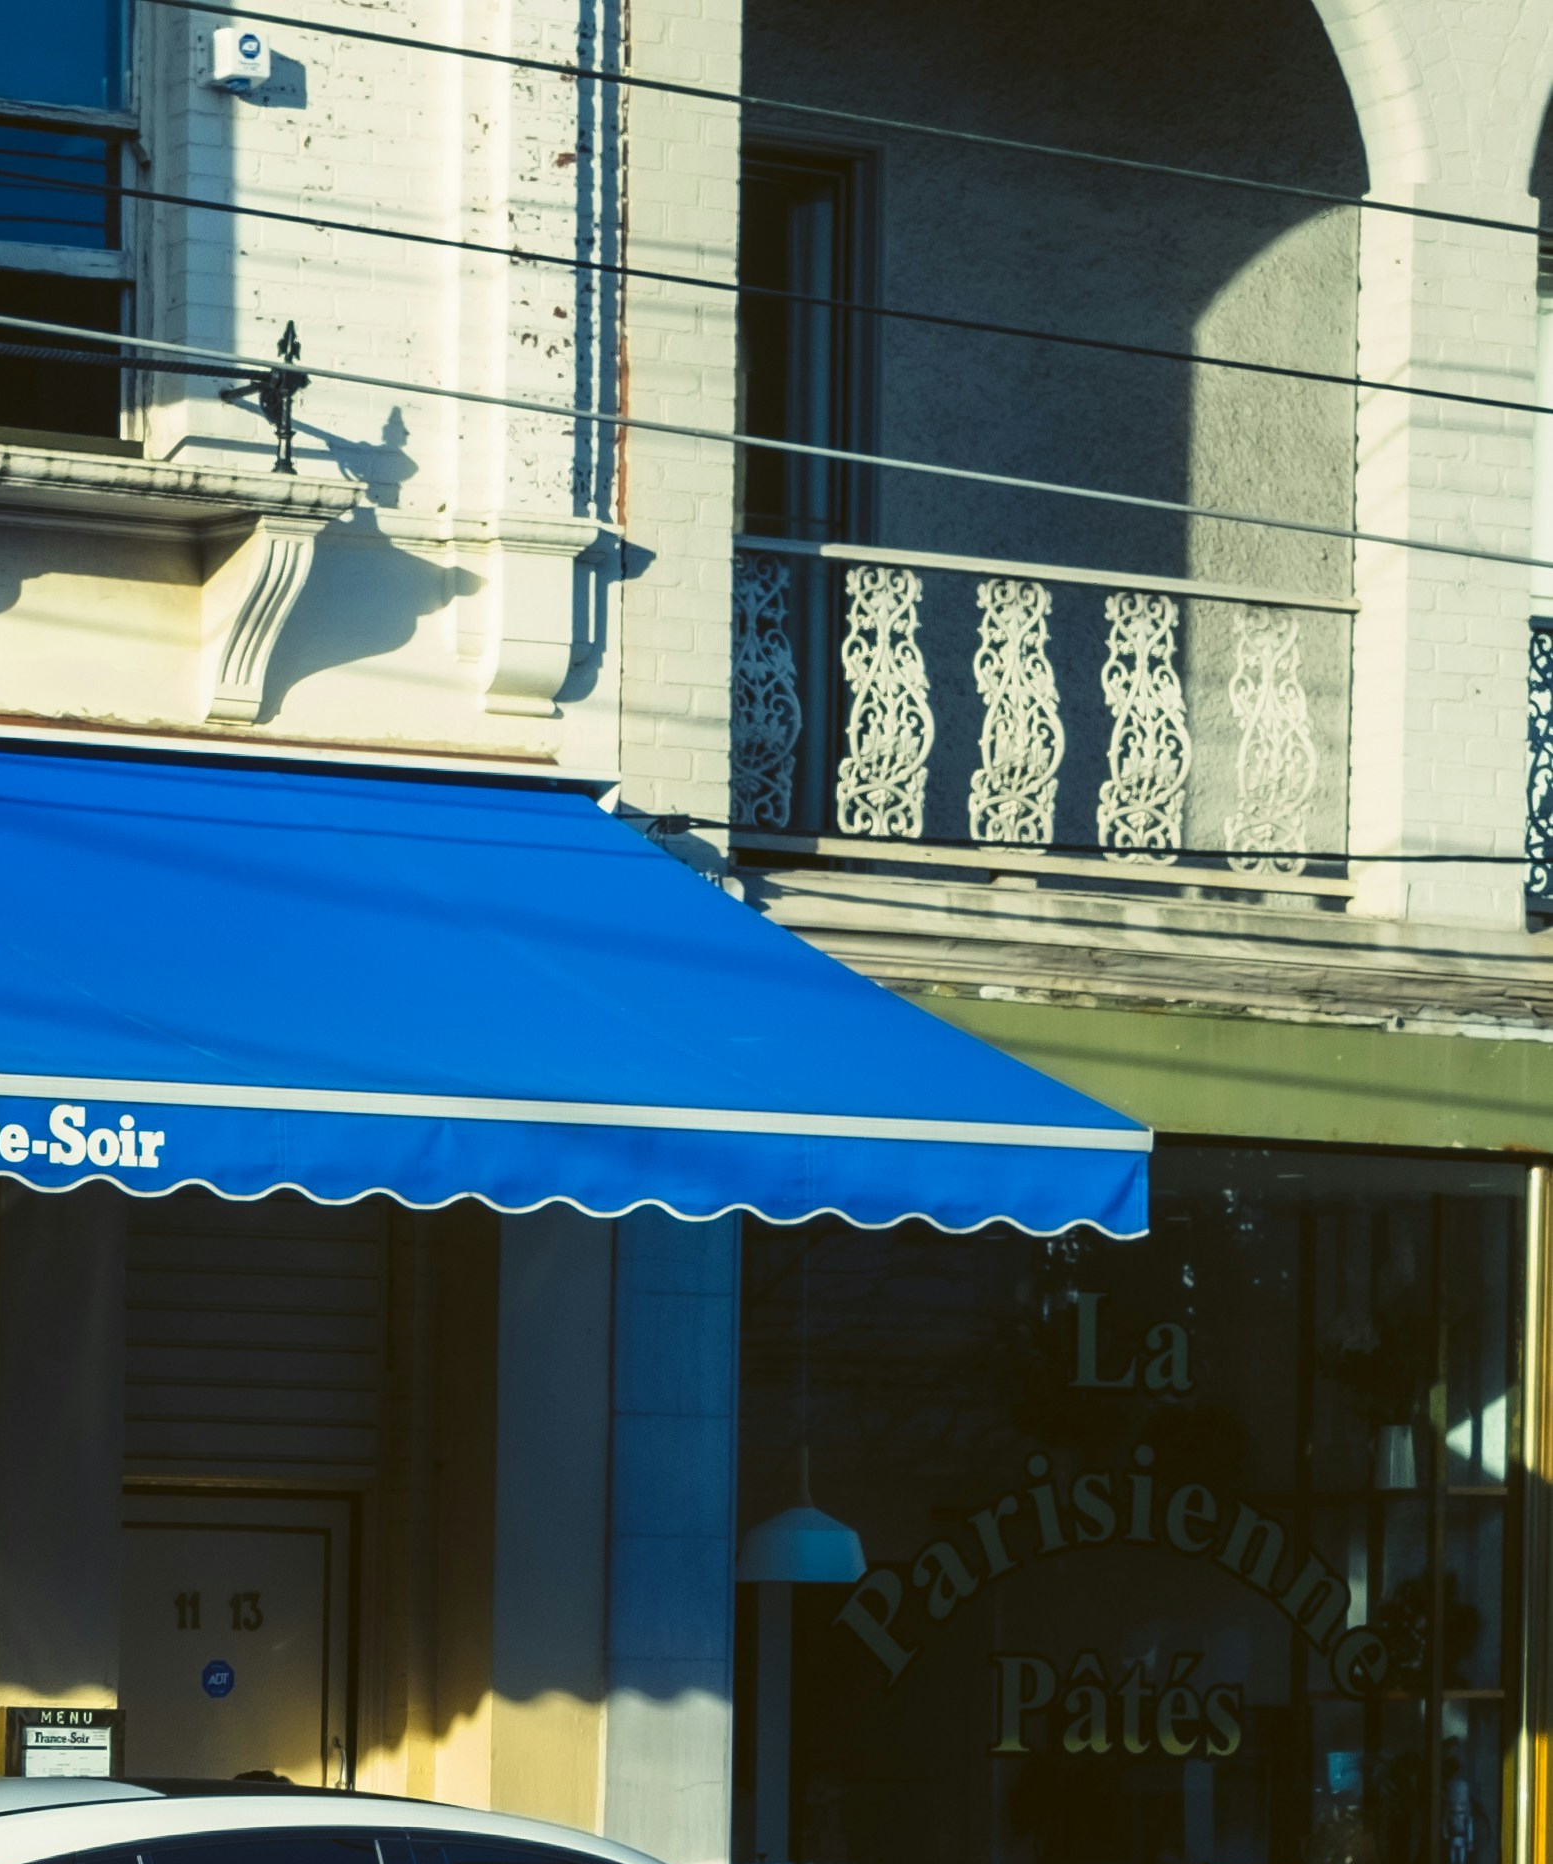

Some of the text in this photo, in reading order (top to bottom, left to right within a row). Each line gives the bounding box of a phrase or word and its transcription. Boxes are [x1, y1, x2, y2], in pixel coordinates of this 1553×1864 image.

[1067, 1291, 1193, 1392] La
[831, 1443, 1390, 1697] Parisienne
[174, 1591, 264, 1632] 11 13
[207, 1672, 230, 1685] ADT
[40, 1710, 94, 1725] MENU
[992, 1653, 1244, 1757] Pâtés
[34, 1731, 90, 1744] France-Soir
